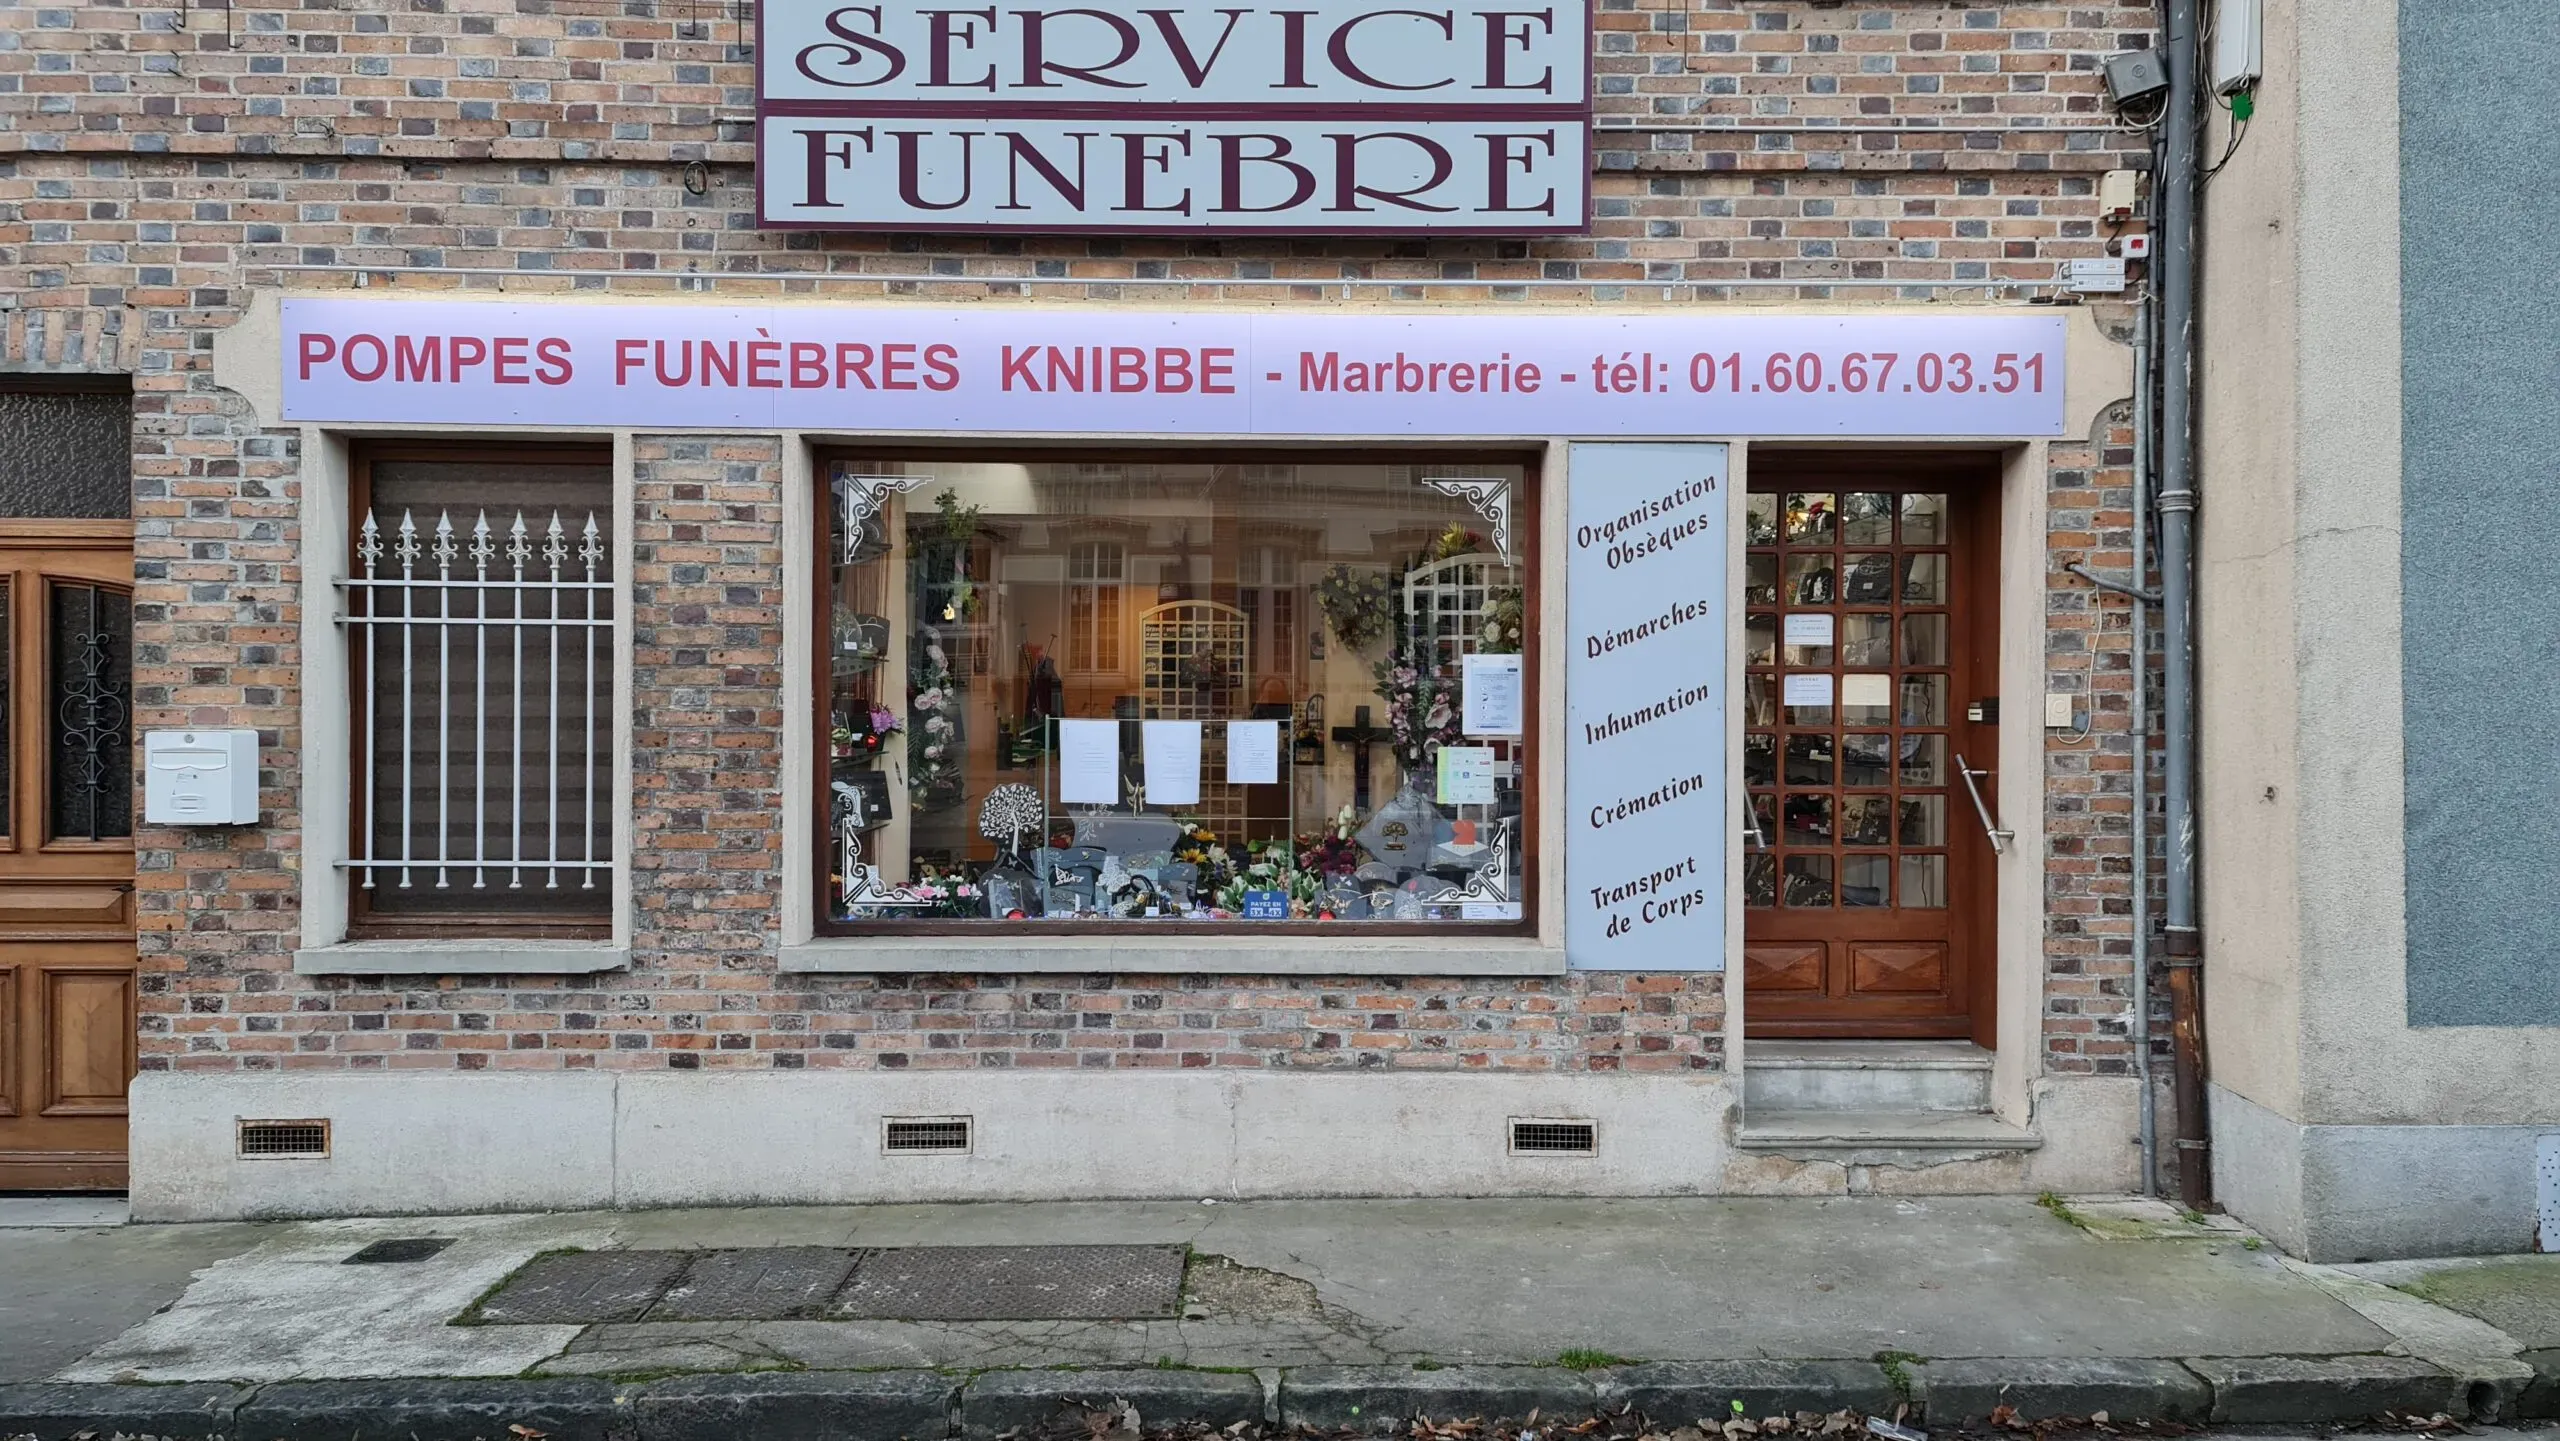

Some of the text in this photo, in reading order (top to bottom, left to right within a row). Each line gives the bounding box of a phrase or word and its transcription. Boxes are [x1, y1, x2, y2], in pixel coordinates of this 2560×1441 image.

[795, 5, 1553, 95] SERVICE
[792, 125, 1555, 218] FUNEBRE
[297, 333, 573, 386] POMPES
[615, 327, 960, 392] FUNÈBRES
[1001, 345, 1236, 394] KNIBBE
[1300, 351, 1541, 394] Marbrerie
[1591, 352, 1668, 394] tél:
[1689, 352, 2045, 394] 01.60.67.03.51
[1577, 475, 1716, 548] Organisation
[1606, 513, 1708, 569] Obsèques
[1587, 600, 1707, 658] Démarches
[1585, 684, 1708, 744] Inhumation
[1590, 774, 1703, 828] Crémation
[1590, 856, 1696, 909] Transport
[1606, 889, 1704, 938] de Corps
